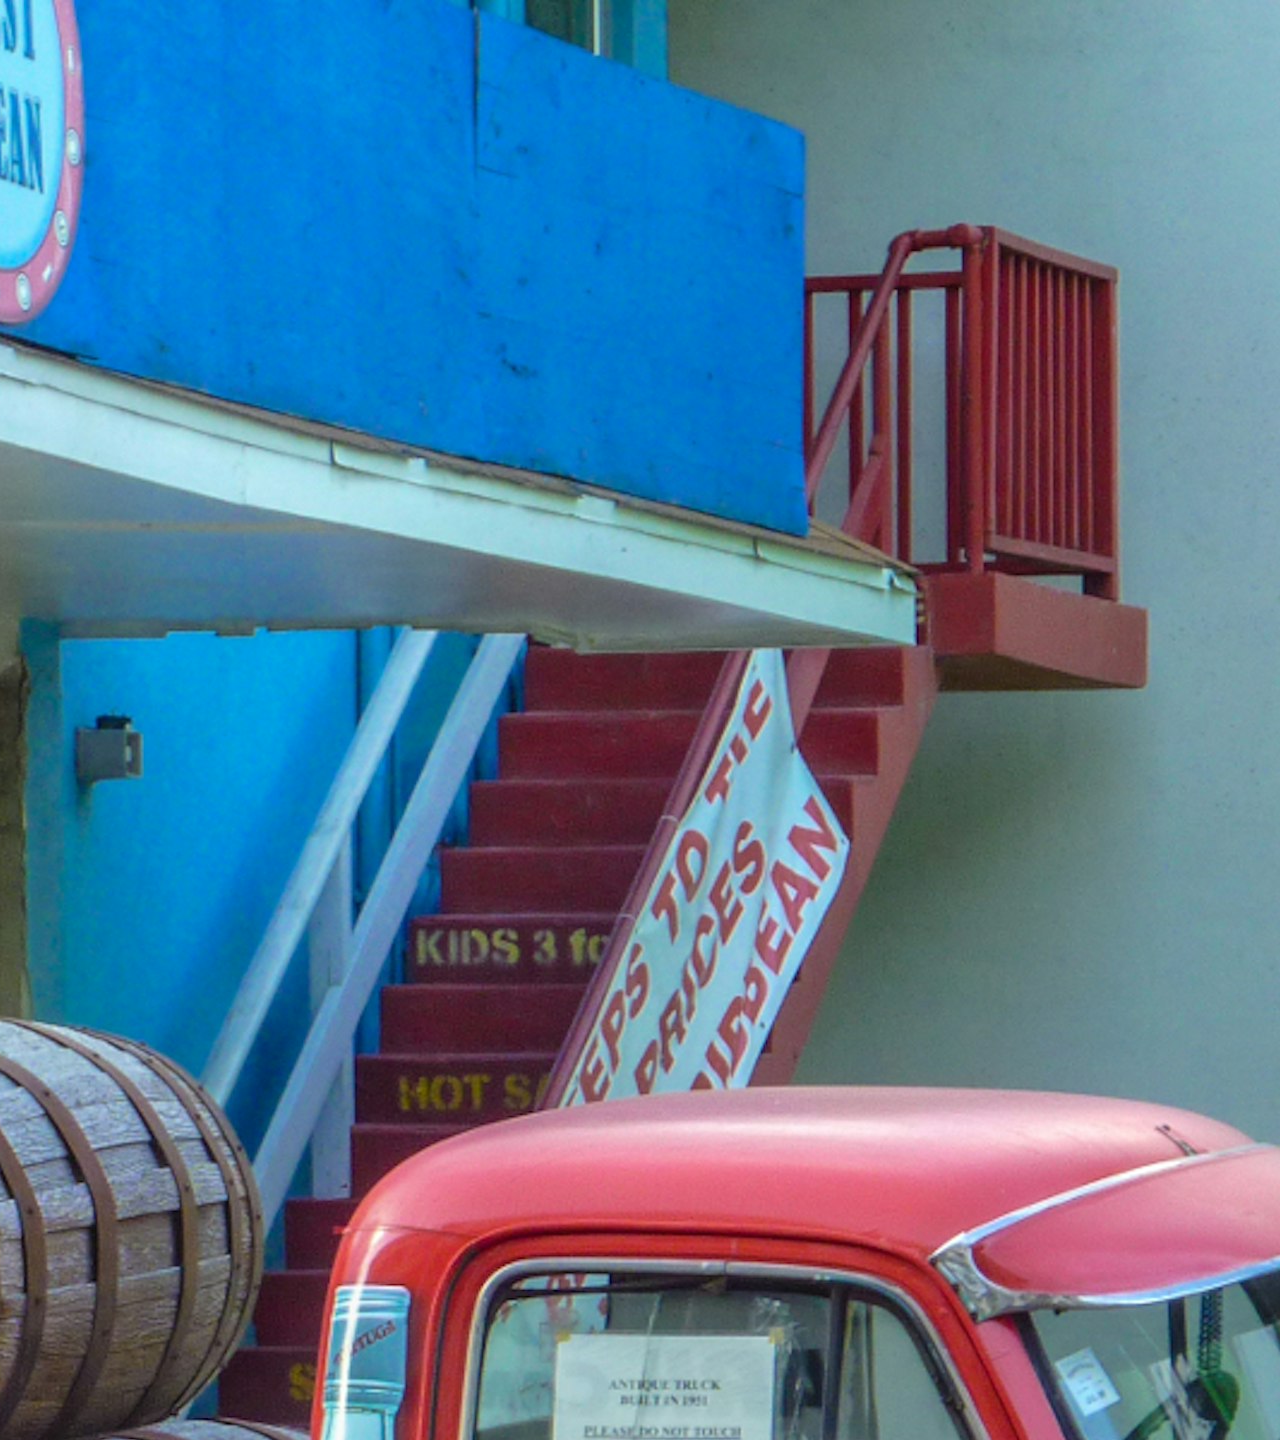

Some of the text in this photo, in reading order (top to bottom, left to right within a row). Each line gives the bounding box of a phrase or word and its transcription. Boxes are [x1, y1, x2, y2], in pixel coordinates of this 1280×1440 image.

[415, 927, 521, 966] KIDS
[532, 929, 557, 966] 3
[398, 1074, 491, 1112] HOT
[608, 1379, 722, 1391] ANTIQUE TRUCK
[620, 1394, 660, 1407] BUILT
[663, 1395, 679, 1406] IN
[583, 1425, 742, 1439] PLEASE DO NOT TOUCH
